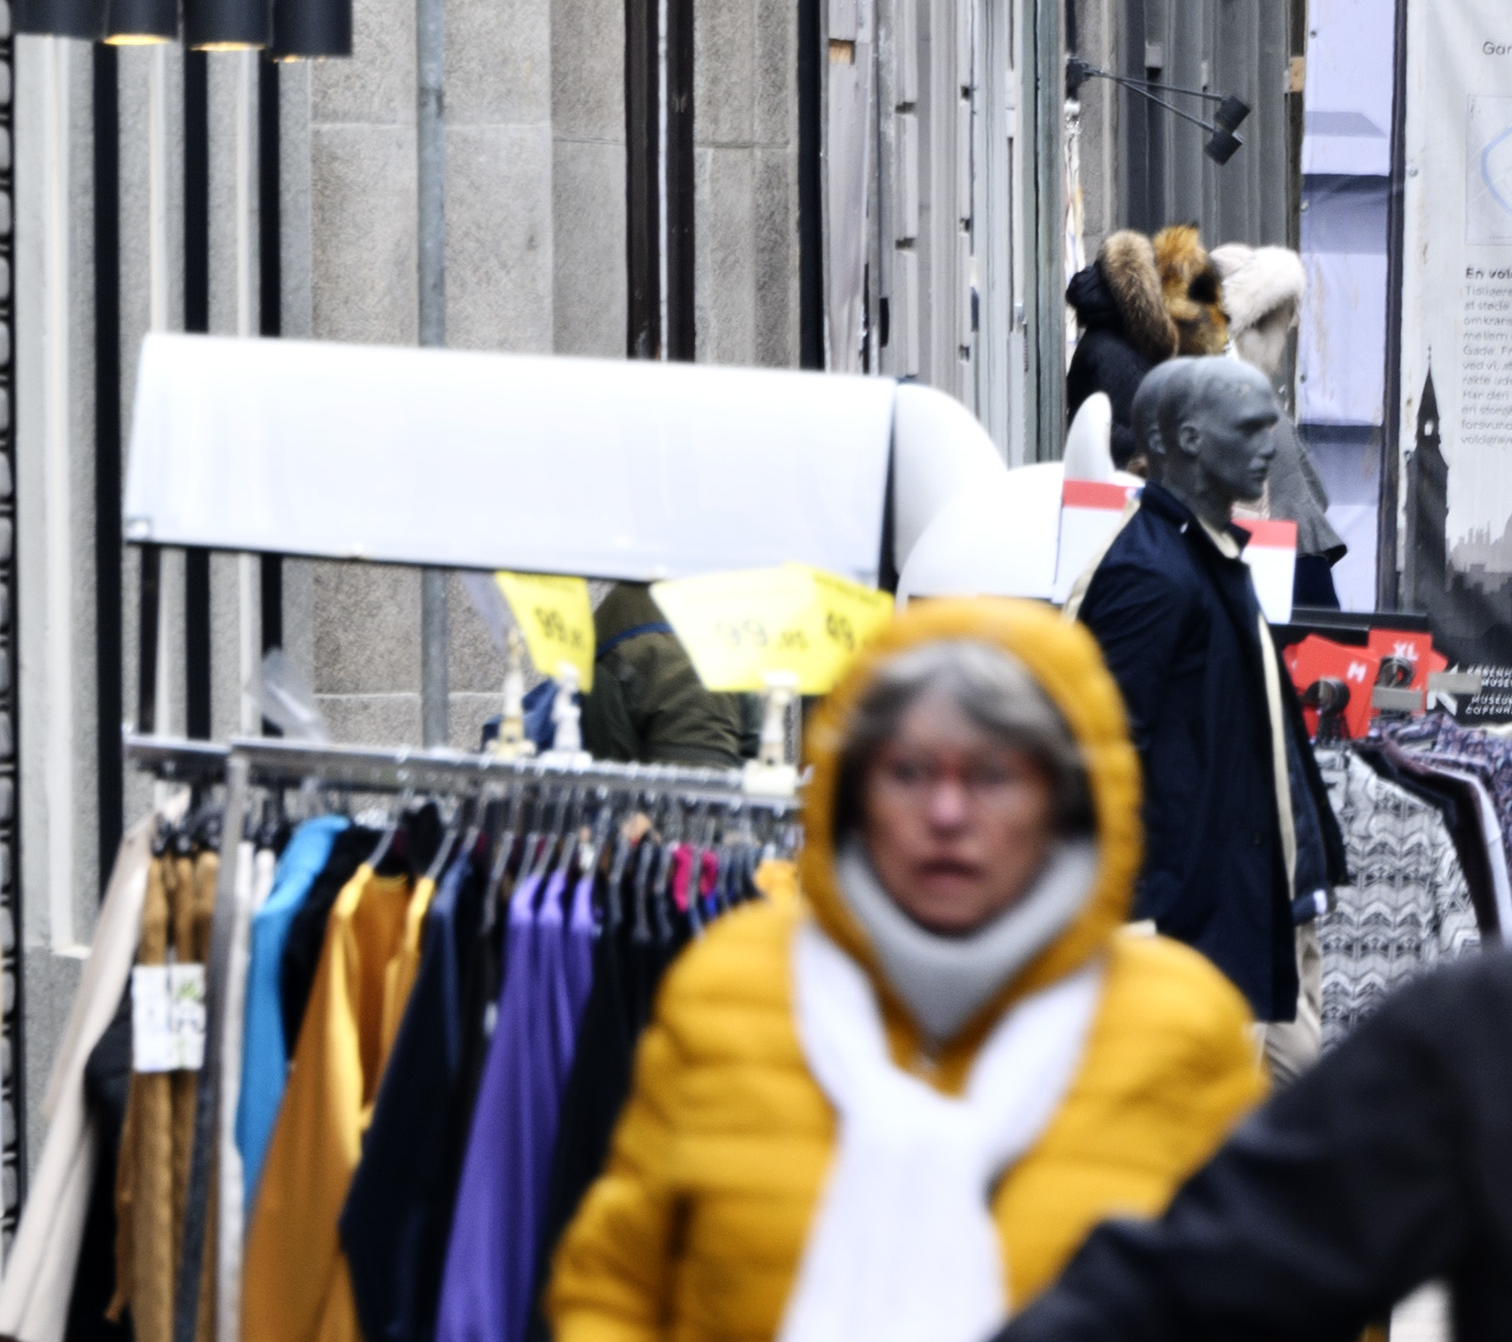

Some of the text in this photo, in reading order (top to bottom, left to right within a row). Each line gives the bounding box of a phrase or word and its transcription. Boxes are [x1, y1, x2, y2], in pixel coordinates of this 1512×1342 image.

[1465, 268, 1484, 280] En
[1392, 640, 1420, 662] XL
[1346, 660, 1368, 683] M
